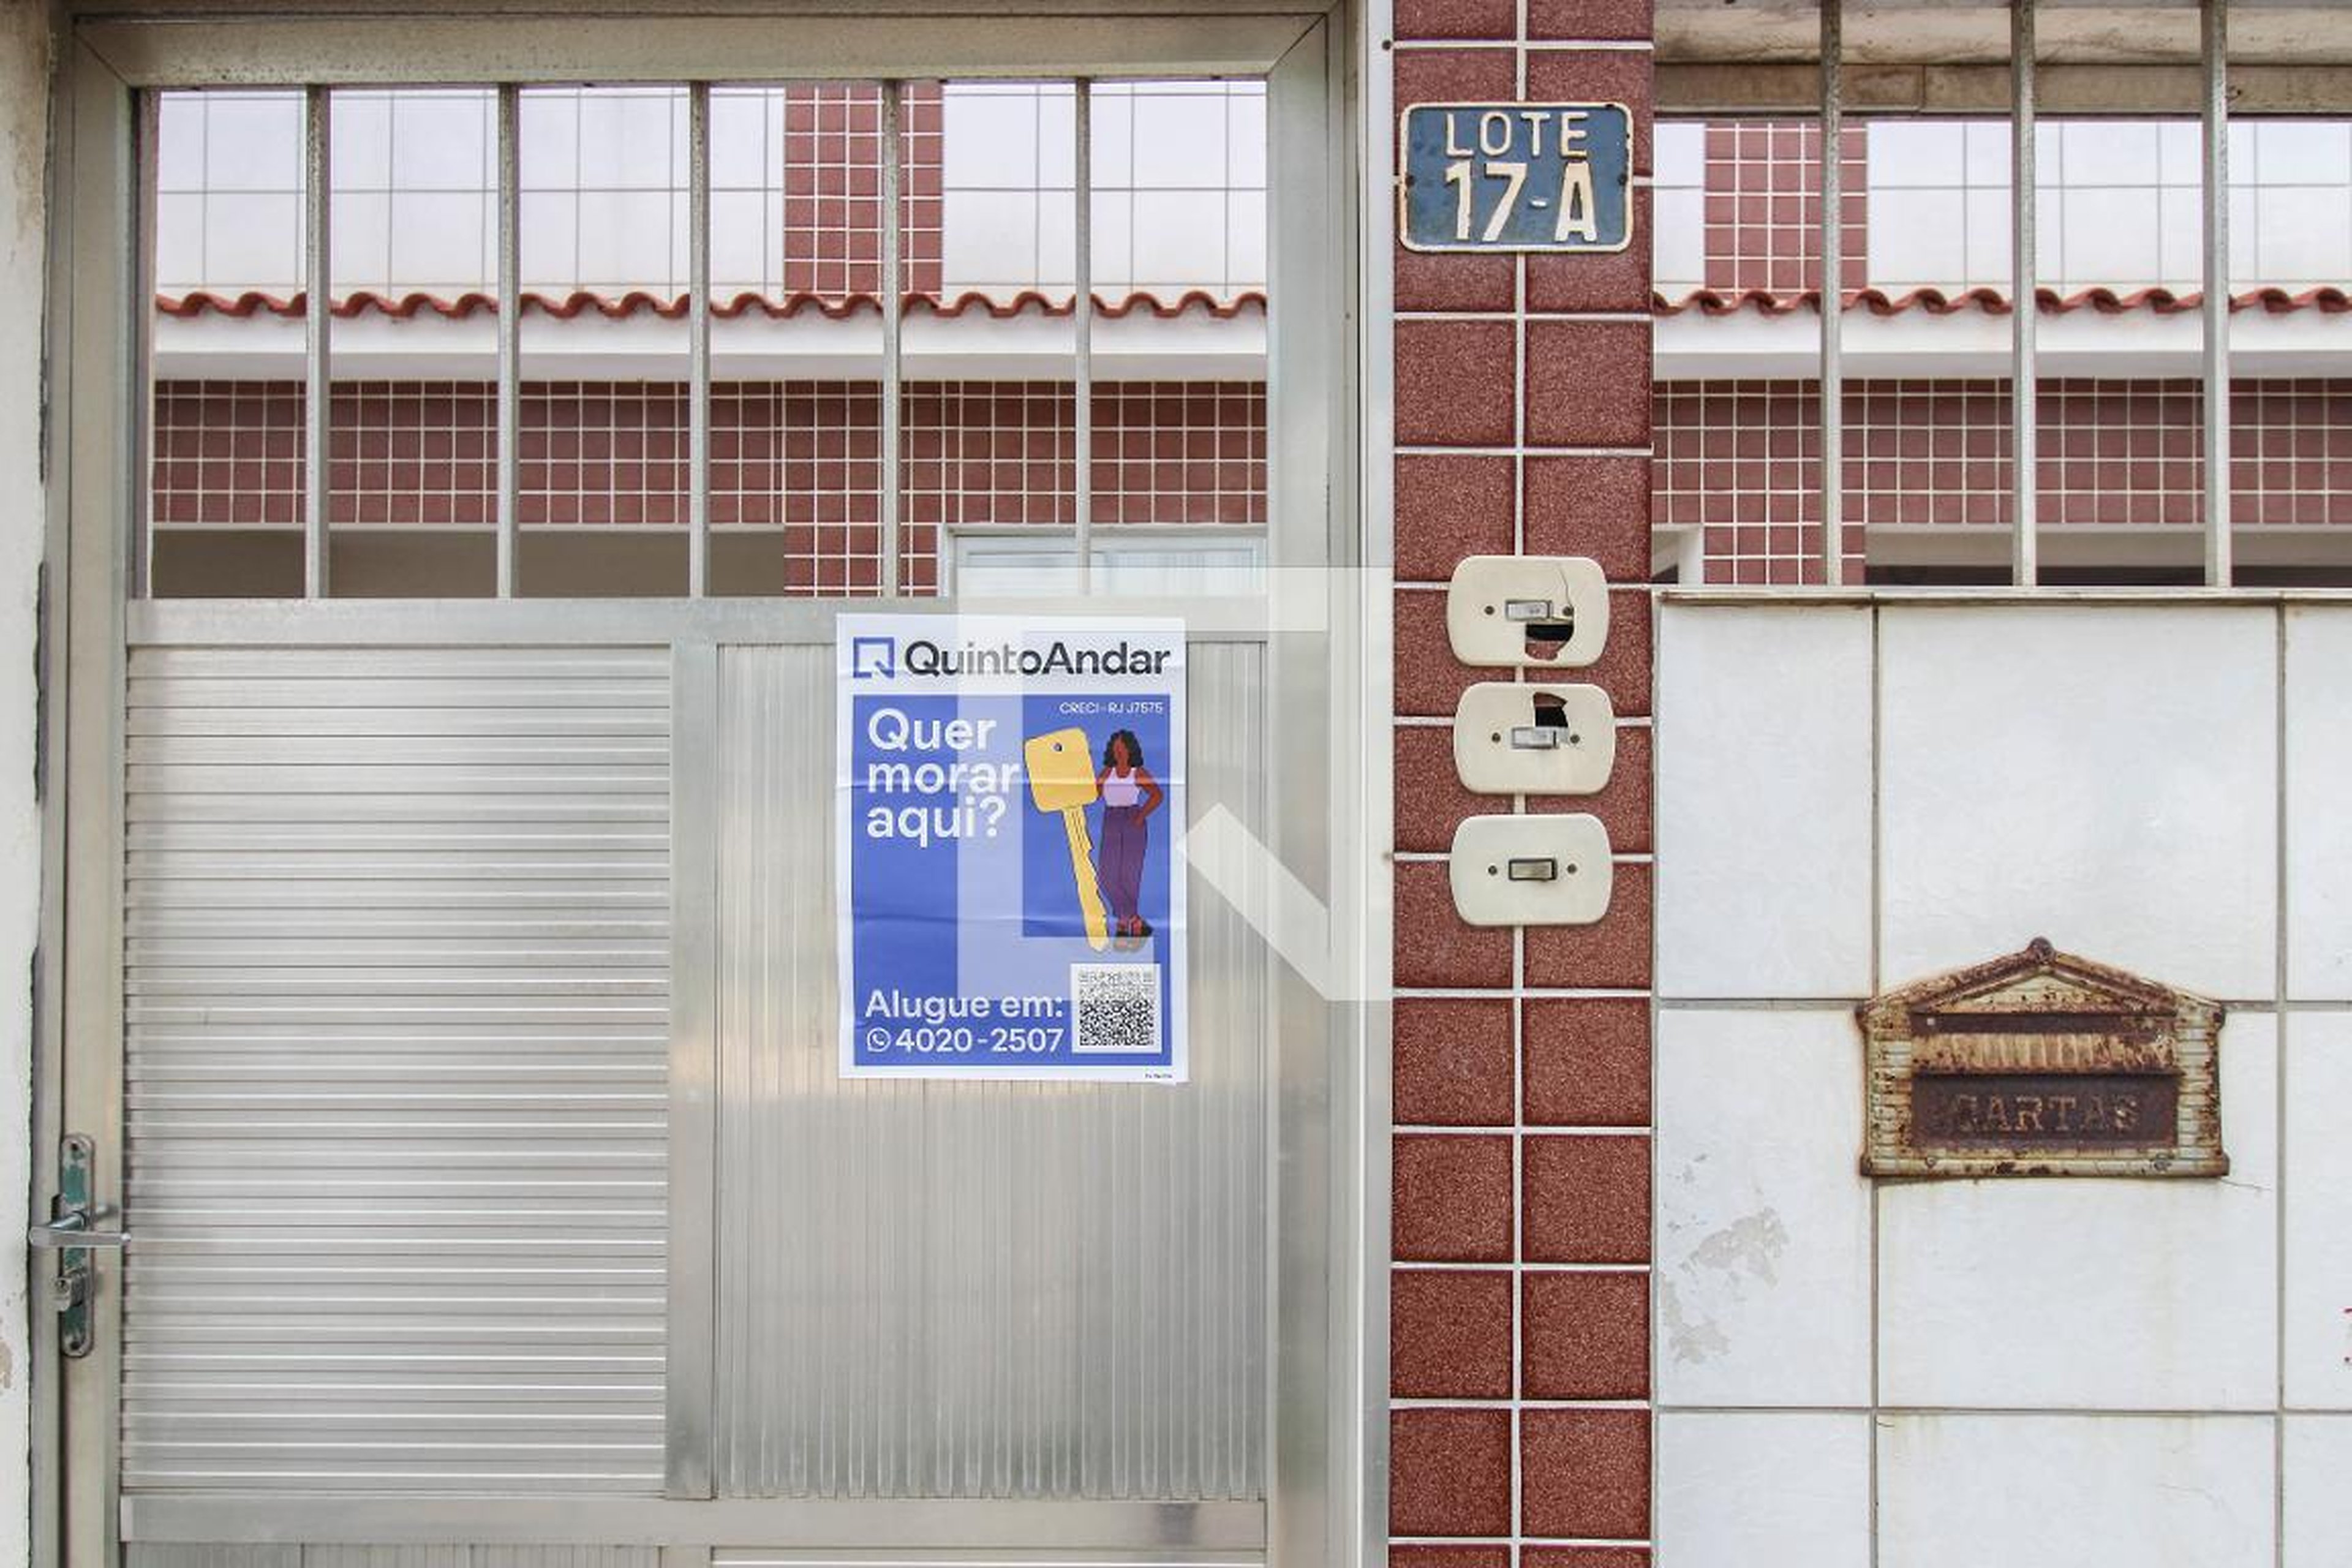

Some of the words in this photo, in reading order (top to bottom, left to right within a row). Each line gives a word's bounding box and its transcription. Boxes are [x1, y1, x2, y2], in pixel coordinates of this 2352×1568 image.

[1447, 111, 1588, 156] LOTE
[1446, 160, 1597, 242] 17-A
[905, 641, 1170, 677] QuintoAndar
[867, 708, 997, 751] Quer
[867, 762, 1019, 794] morar
[867, 796, 1005, 847] aqui?
[865, 990, 989, 1023] Alugue
[1000, 997, 1063, 1018] em:
[895, 1028, 1063, 1052] 4020-2507
